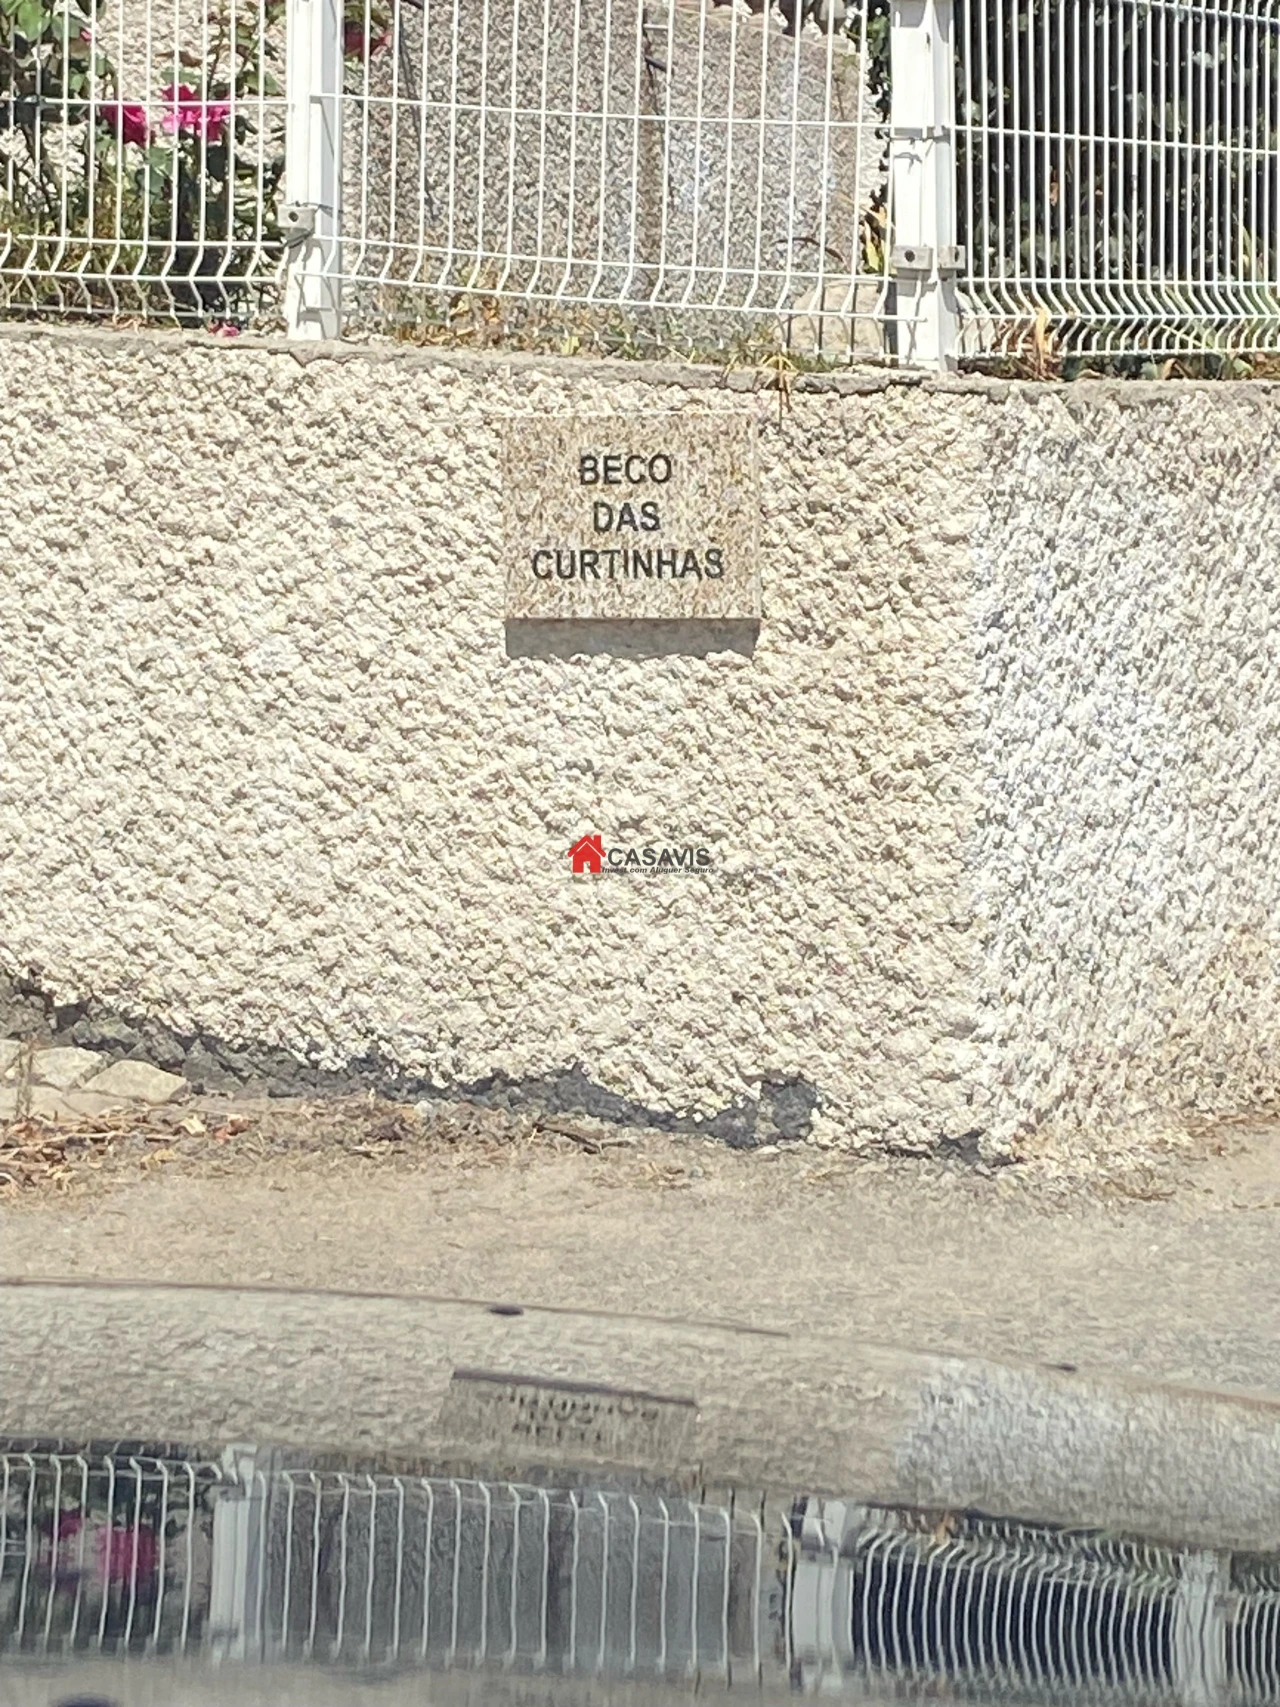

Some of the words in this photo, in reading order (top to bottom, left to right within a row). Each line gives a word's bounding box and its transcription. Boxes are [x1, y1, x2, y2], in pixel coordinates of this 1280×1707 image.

[579, 453, 673, 485] BECO
[593, 501, 661, 532] DAS
[531, 549, 724, 581] CURTINHAS
